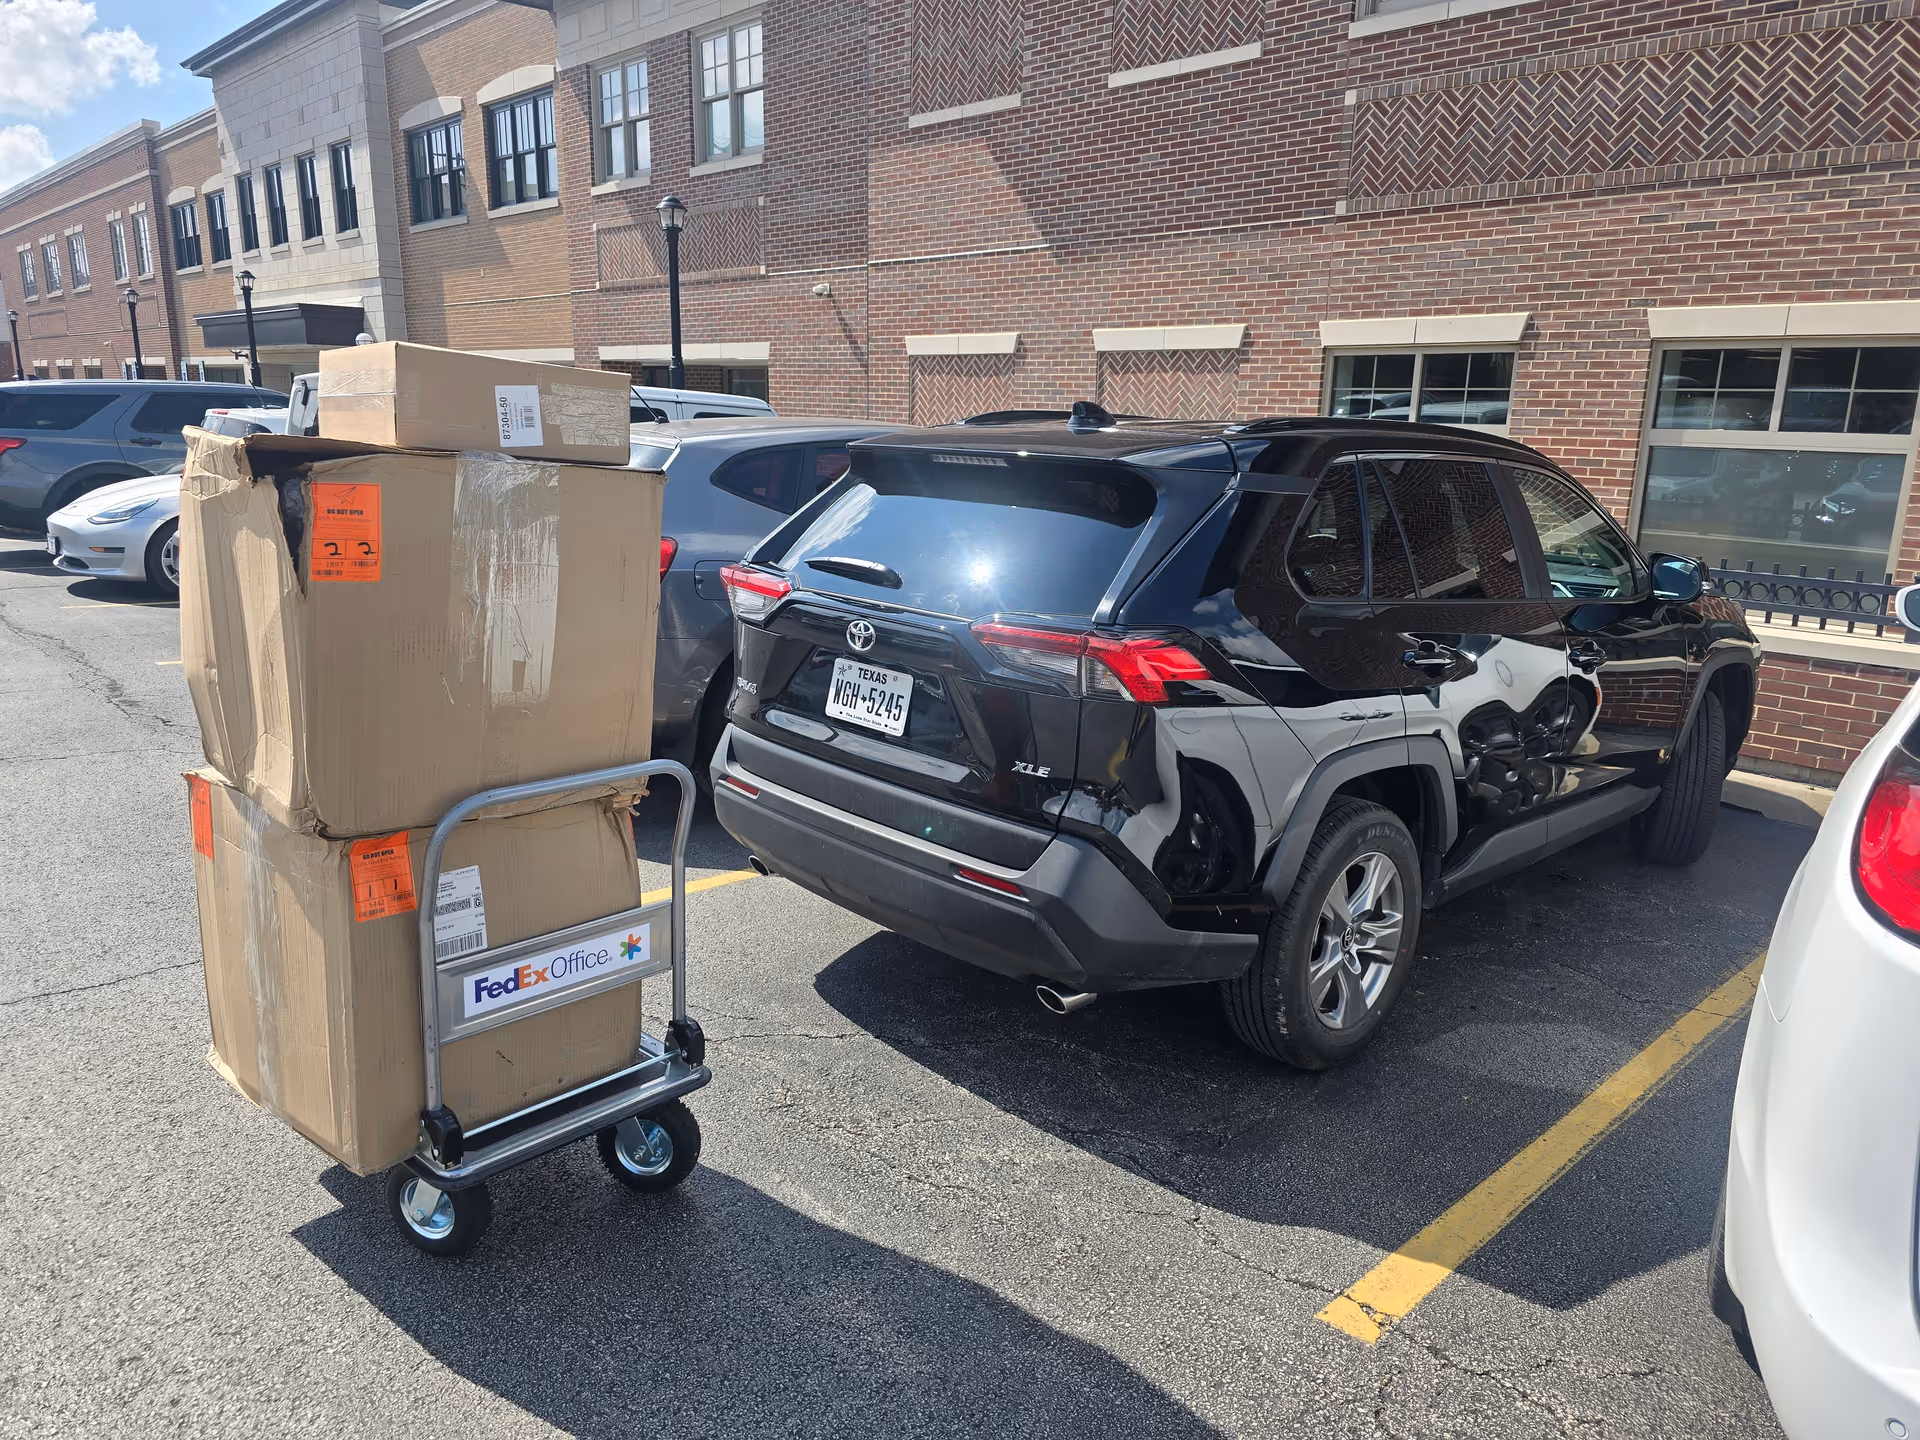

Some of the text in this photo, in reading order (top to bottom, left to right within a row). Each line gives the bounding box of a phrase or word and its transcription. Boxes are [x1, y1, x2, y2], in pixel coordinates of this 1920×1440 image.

[499, 396, 512, 440] 87304-50
[324, 541, 376, 556] 2 2
[858, 667, 888, 685] TEXAS
[833, 678, 905, 722] WGH 5245
[1011, 760, 1051, 778] XLE
[1366, 824, 1410, 847] DUNLOP
[370, 851, 381, 859] NOT
[381, 848, 395, 857] OPEN
[475, 948, 609, 1004] FedEx Office
